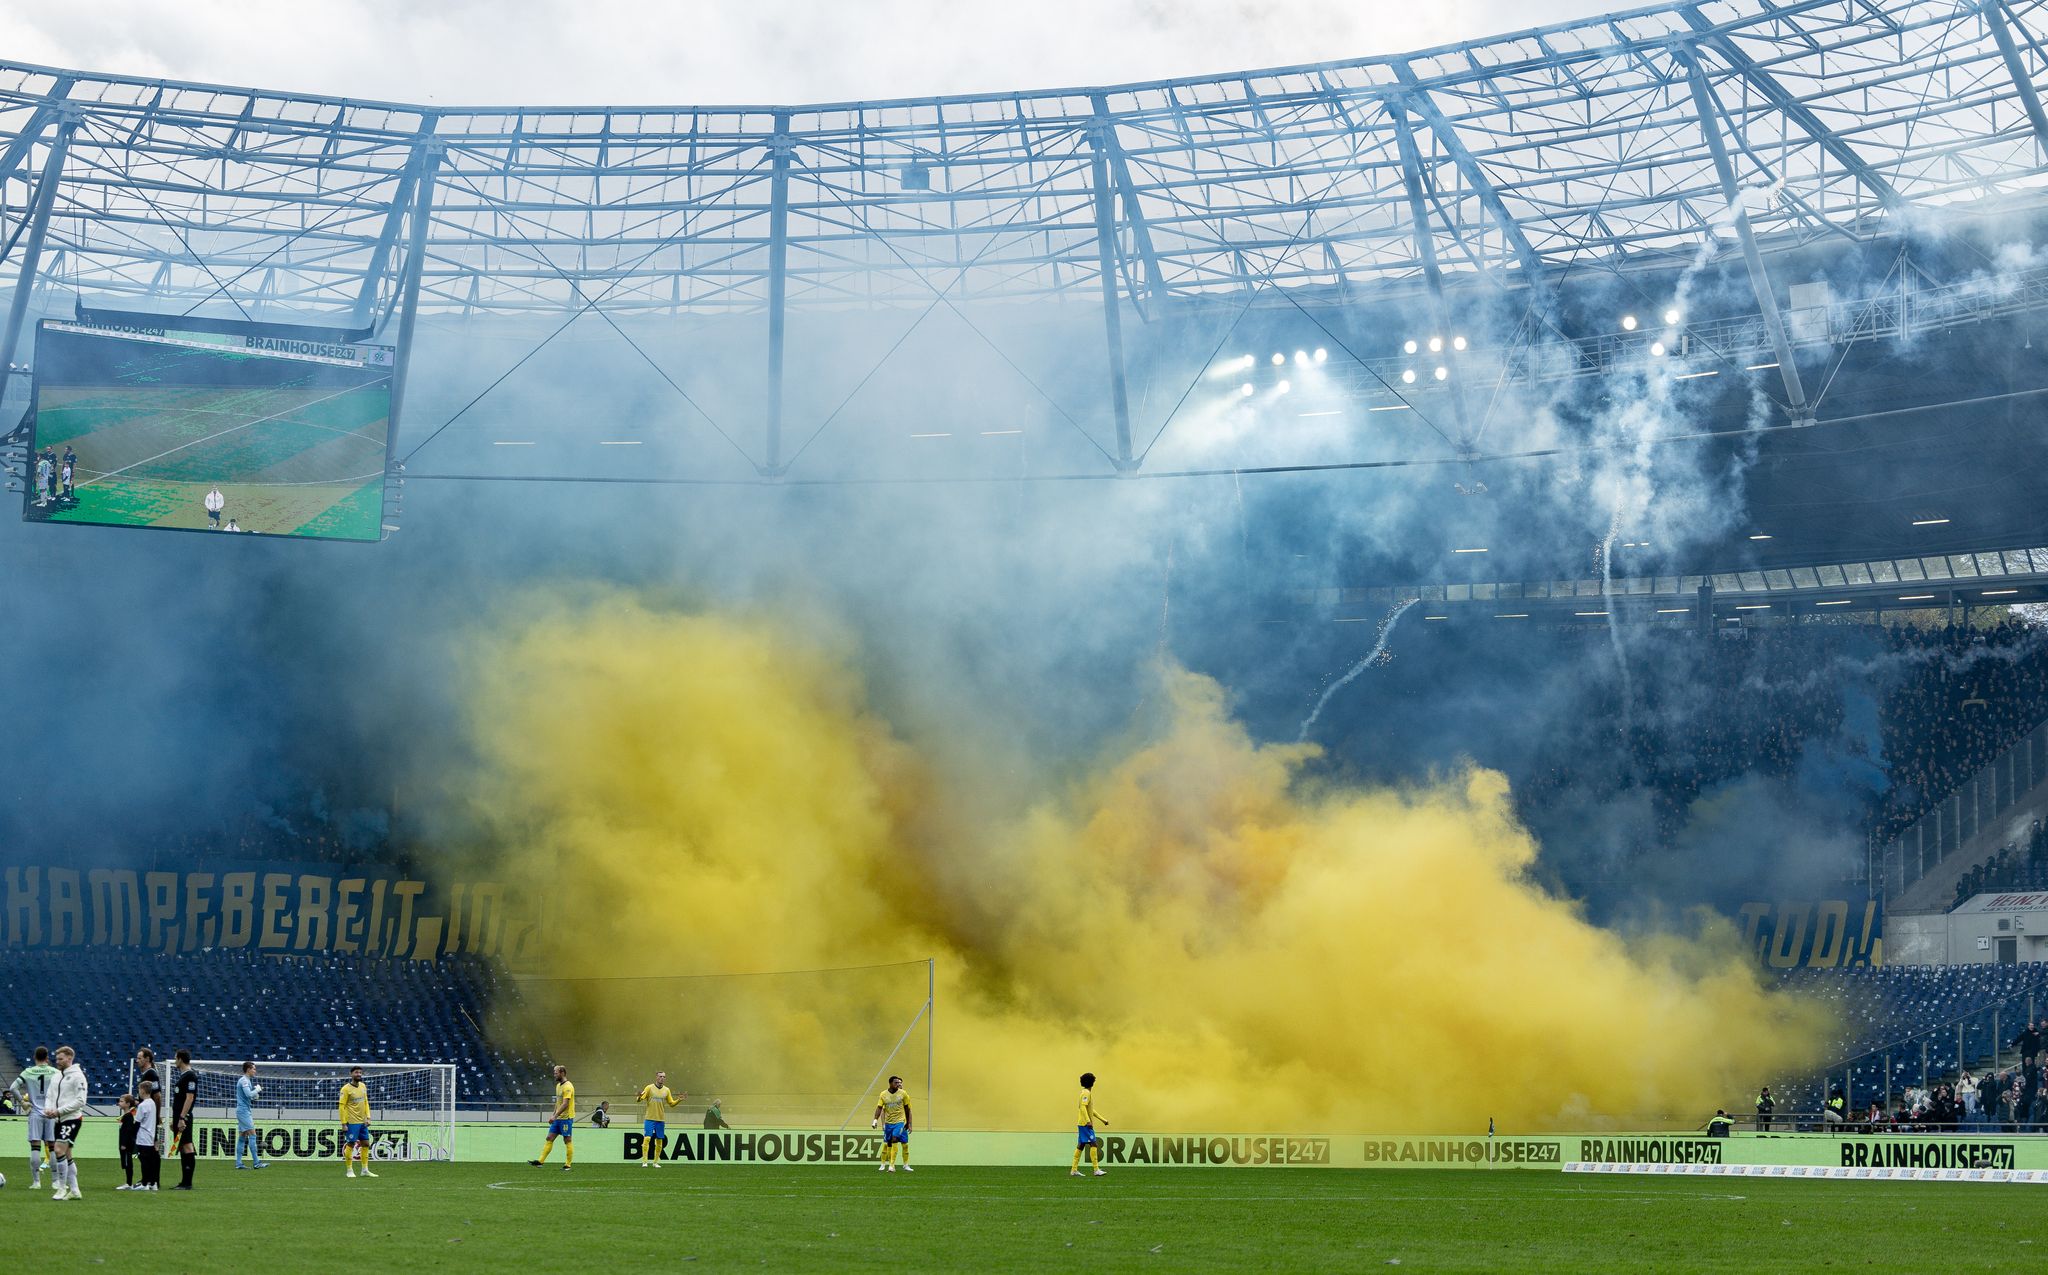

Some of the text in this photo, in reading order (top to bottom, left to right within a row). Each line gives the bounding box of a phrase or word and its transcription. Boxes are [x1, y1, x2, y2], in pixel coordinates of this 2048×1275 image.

[37, 1074, 45, 1095] 1
[60, 1125, 72, 1136] 32
[1363, 1141, 1560, 1163] BRAINHOUSE247
[1580, 1139, 1722, 1164] BRAINHOUSE247
